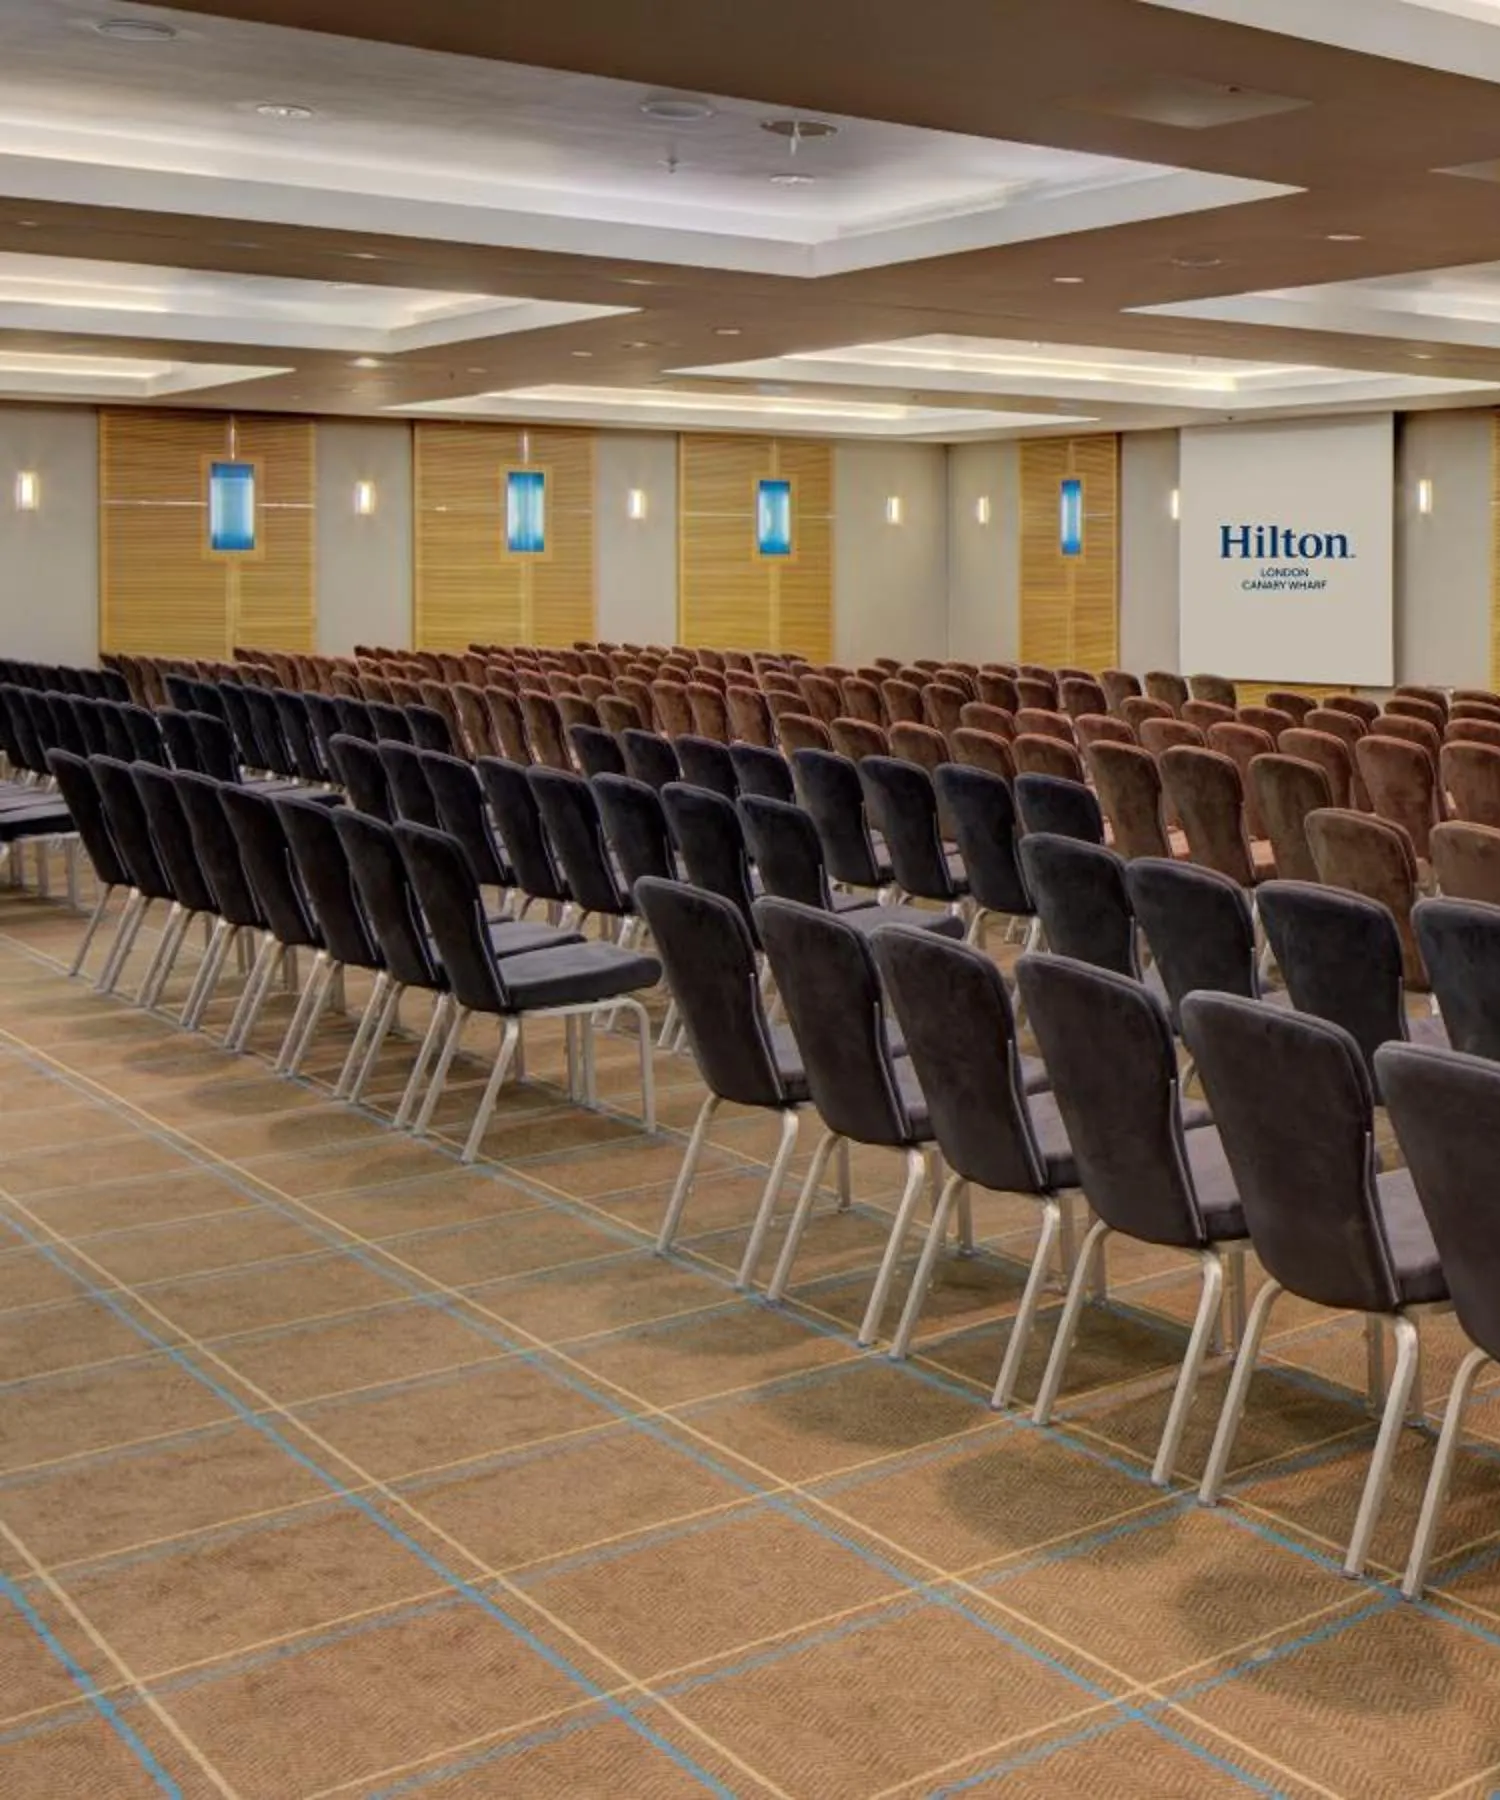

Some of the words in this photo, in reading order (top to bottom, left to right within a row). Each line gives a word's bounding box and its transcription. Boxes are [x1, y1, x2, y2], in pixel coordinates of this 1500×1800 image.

[1219, 525, 1349, 559] Hilton
[1260, 567, 1309, 578] LONDON
[1241, 579, 1286, 590] CANARY
[1287, 579, 1327, 590] WHARF
